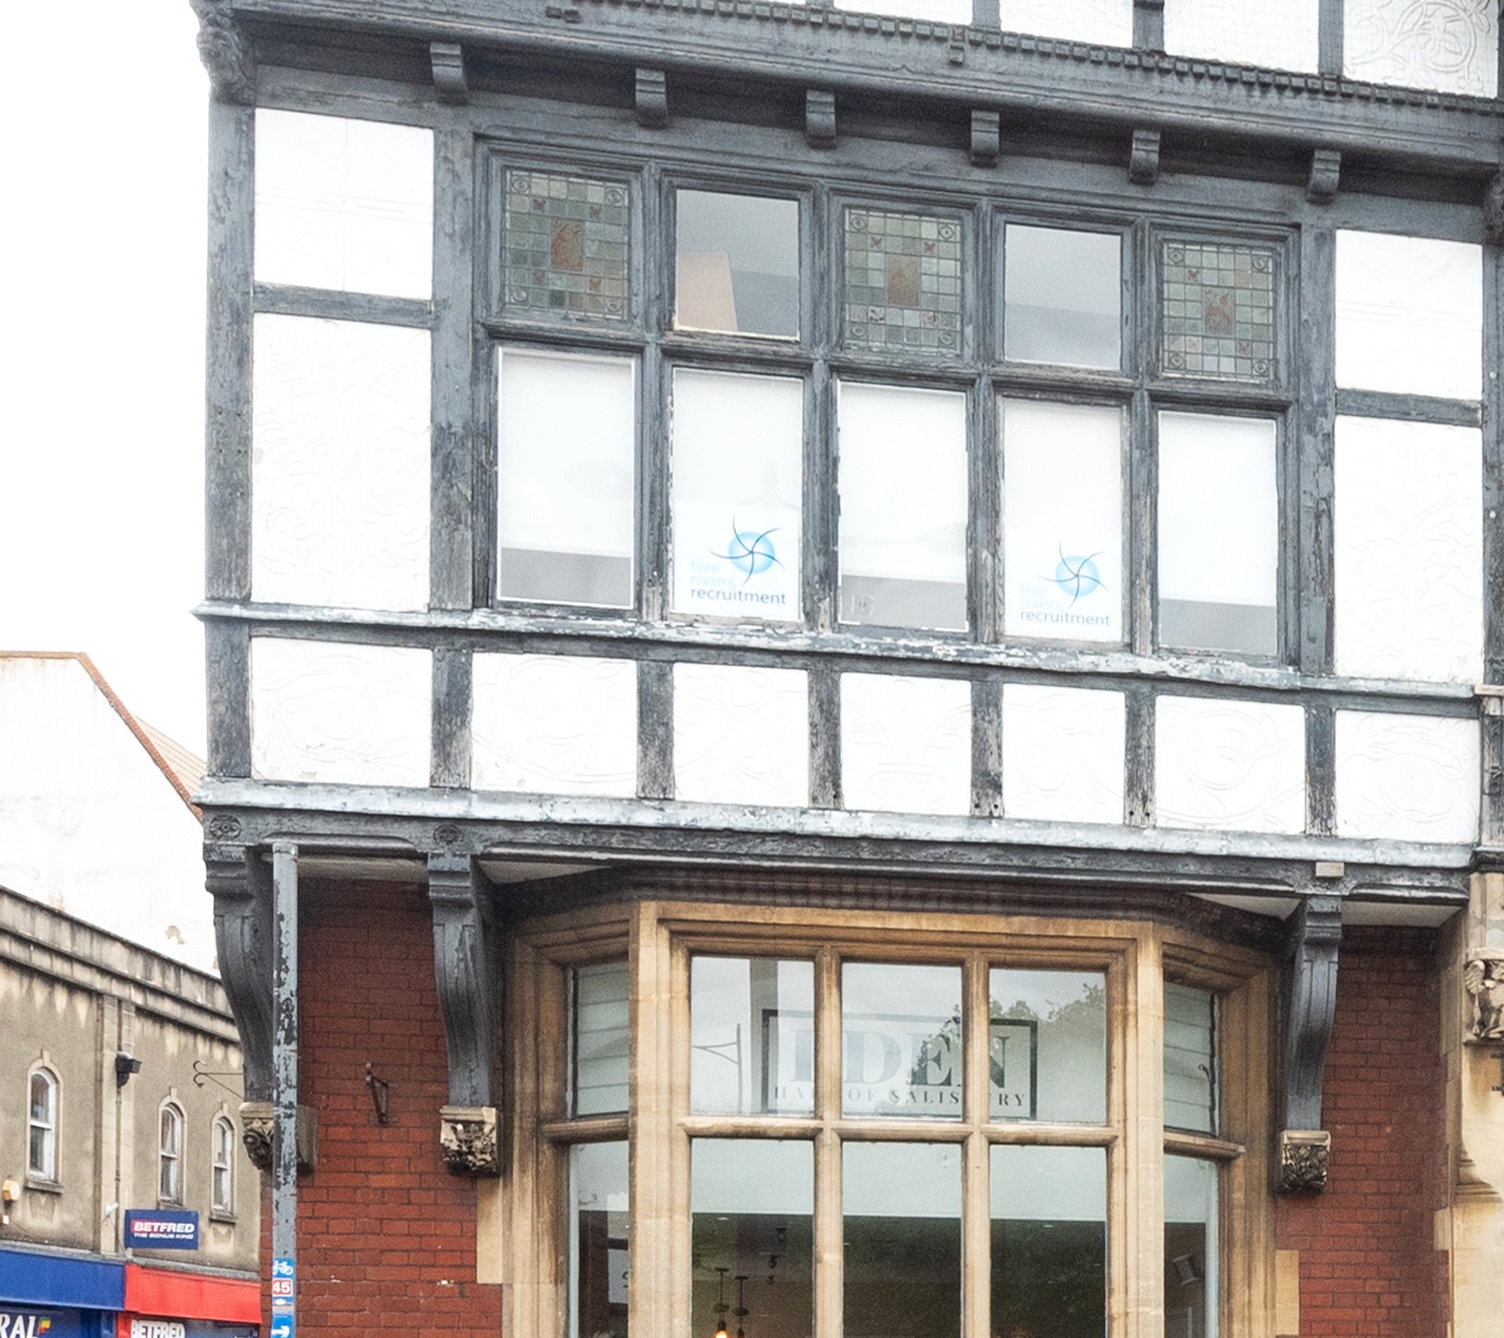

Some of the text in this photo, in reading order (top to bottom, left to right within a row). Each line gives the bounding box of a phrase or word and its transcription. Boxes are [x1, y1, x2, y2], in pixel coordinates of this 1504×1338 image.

[690, 586, 787, 606] recruitment
[1019, 609, 1111, 627] recruitment
[889, 1089, 1025, 1107] SALISRY
[132, 1221, 195, 1234] BETFRED
[272, 1281, 291, 1294] 45
